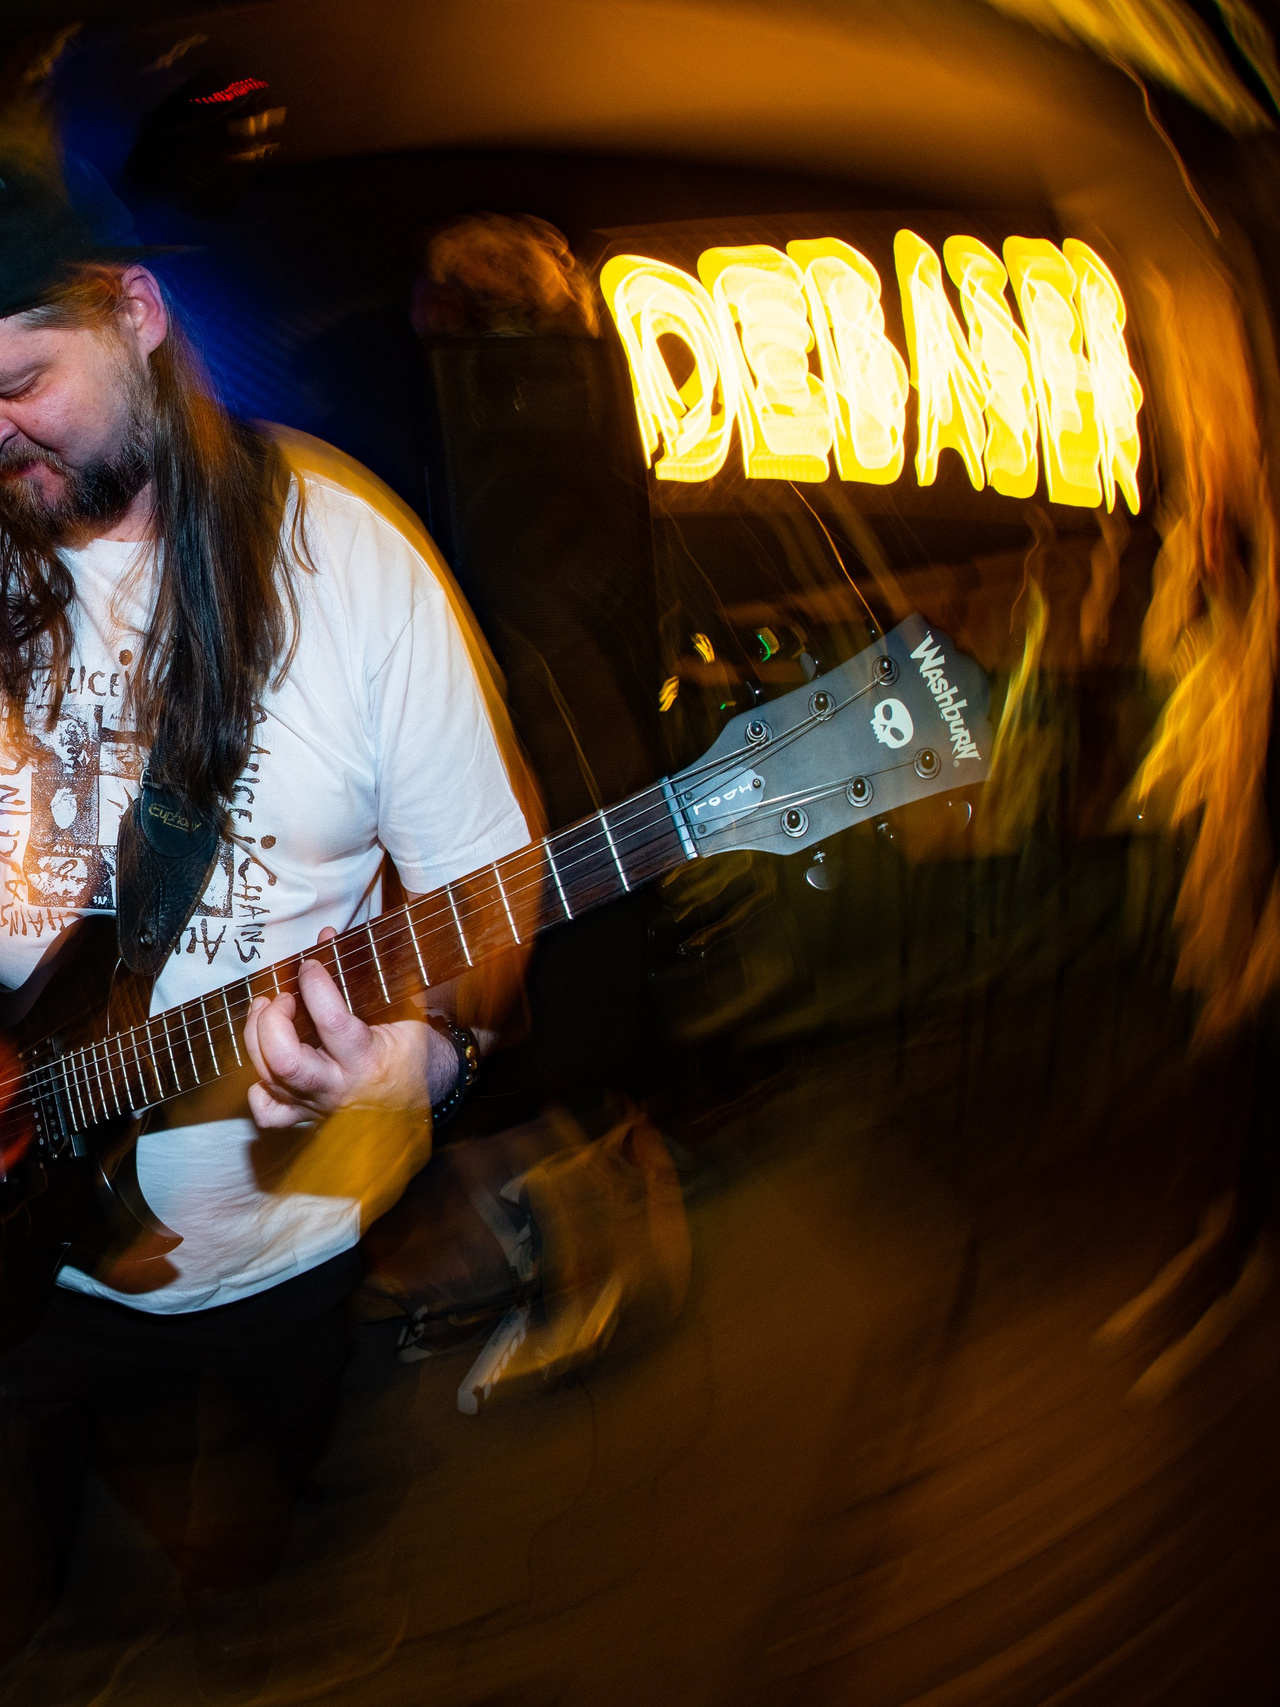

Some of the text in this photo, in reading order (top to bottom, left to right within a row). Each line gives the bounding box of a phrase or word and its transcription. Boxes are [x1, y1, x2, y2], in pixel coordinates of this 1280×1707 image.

[692, 781, 754, 816] IDOL
[148, 803, 202, 832] Euphoy
[0, 902, 84, 937] HAINS
[233, 856, 278, 964] CHAINS
